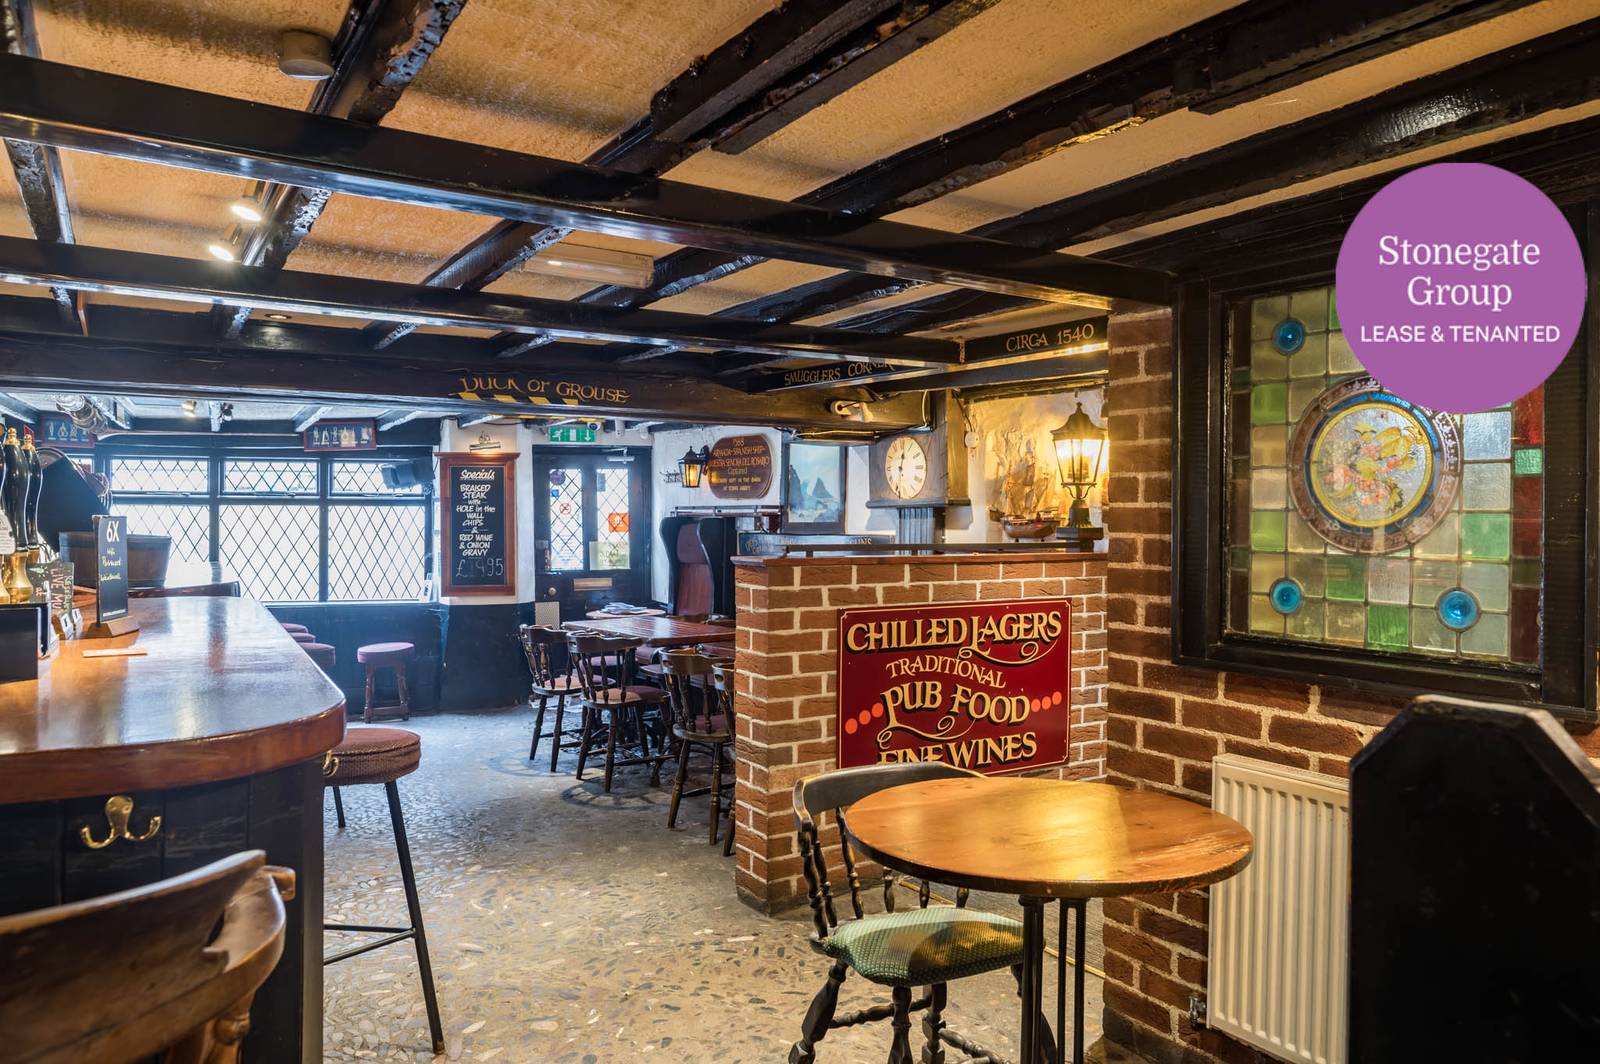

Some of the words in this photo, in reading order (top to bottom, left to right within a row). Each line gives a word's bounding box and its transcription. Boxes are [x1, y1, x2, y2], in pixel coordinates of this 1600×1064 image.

[1006, 332, 1048, 352] CIRCA
[1057, 323, 1094, 345] 1540
[784, 367, 841, 386] SMUGGLERS
[556, 381, 632, 403] GROUSE
[459, 469, 496, 480] Specials
[462, 491, 487, 500] STEAK
[456, 505, 474, 513] HOLE
[484, 504, 496, 513] the
[106, 521, 120, 543] 6X
[459, 533, 474, 541] RED
[475, 533, 494, 541] WINE
[462, 549, 488, 557] GRAVY
[467, 541, 491, 549] ONION
[846, 617, 968, 652] CHILLED
[964, 611, 1063, 656] LAGERS
[885, 654, 1007, 689] TRADITIONAL
[879, 680, 943, 729] PUB
[950, 684, 1031, 725] FOOD
[947, 731, 1038, 768] WINES
